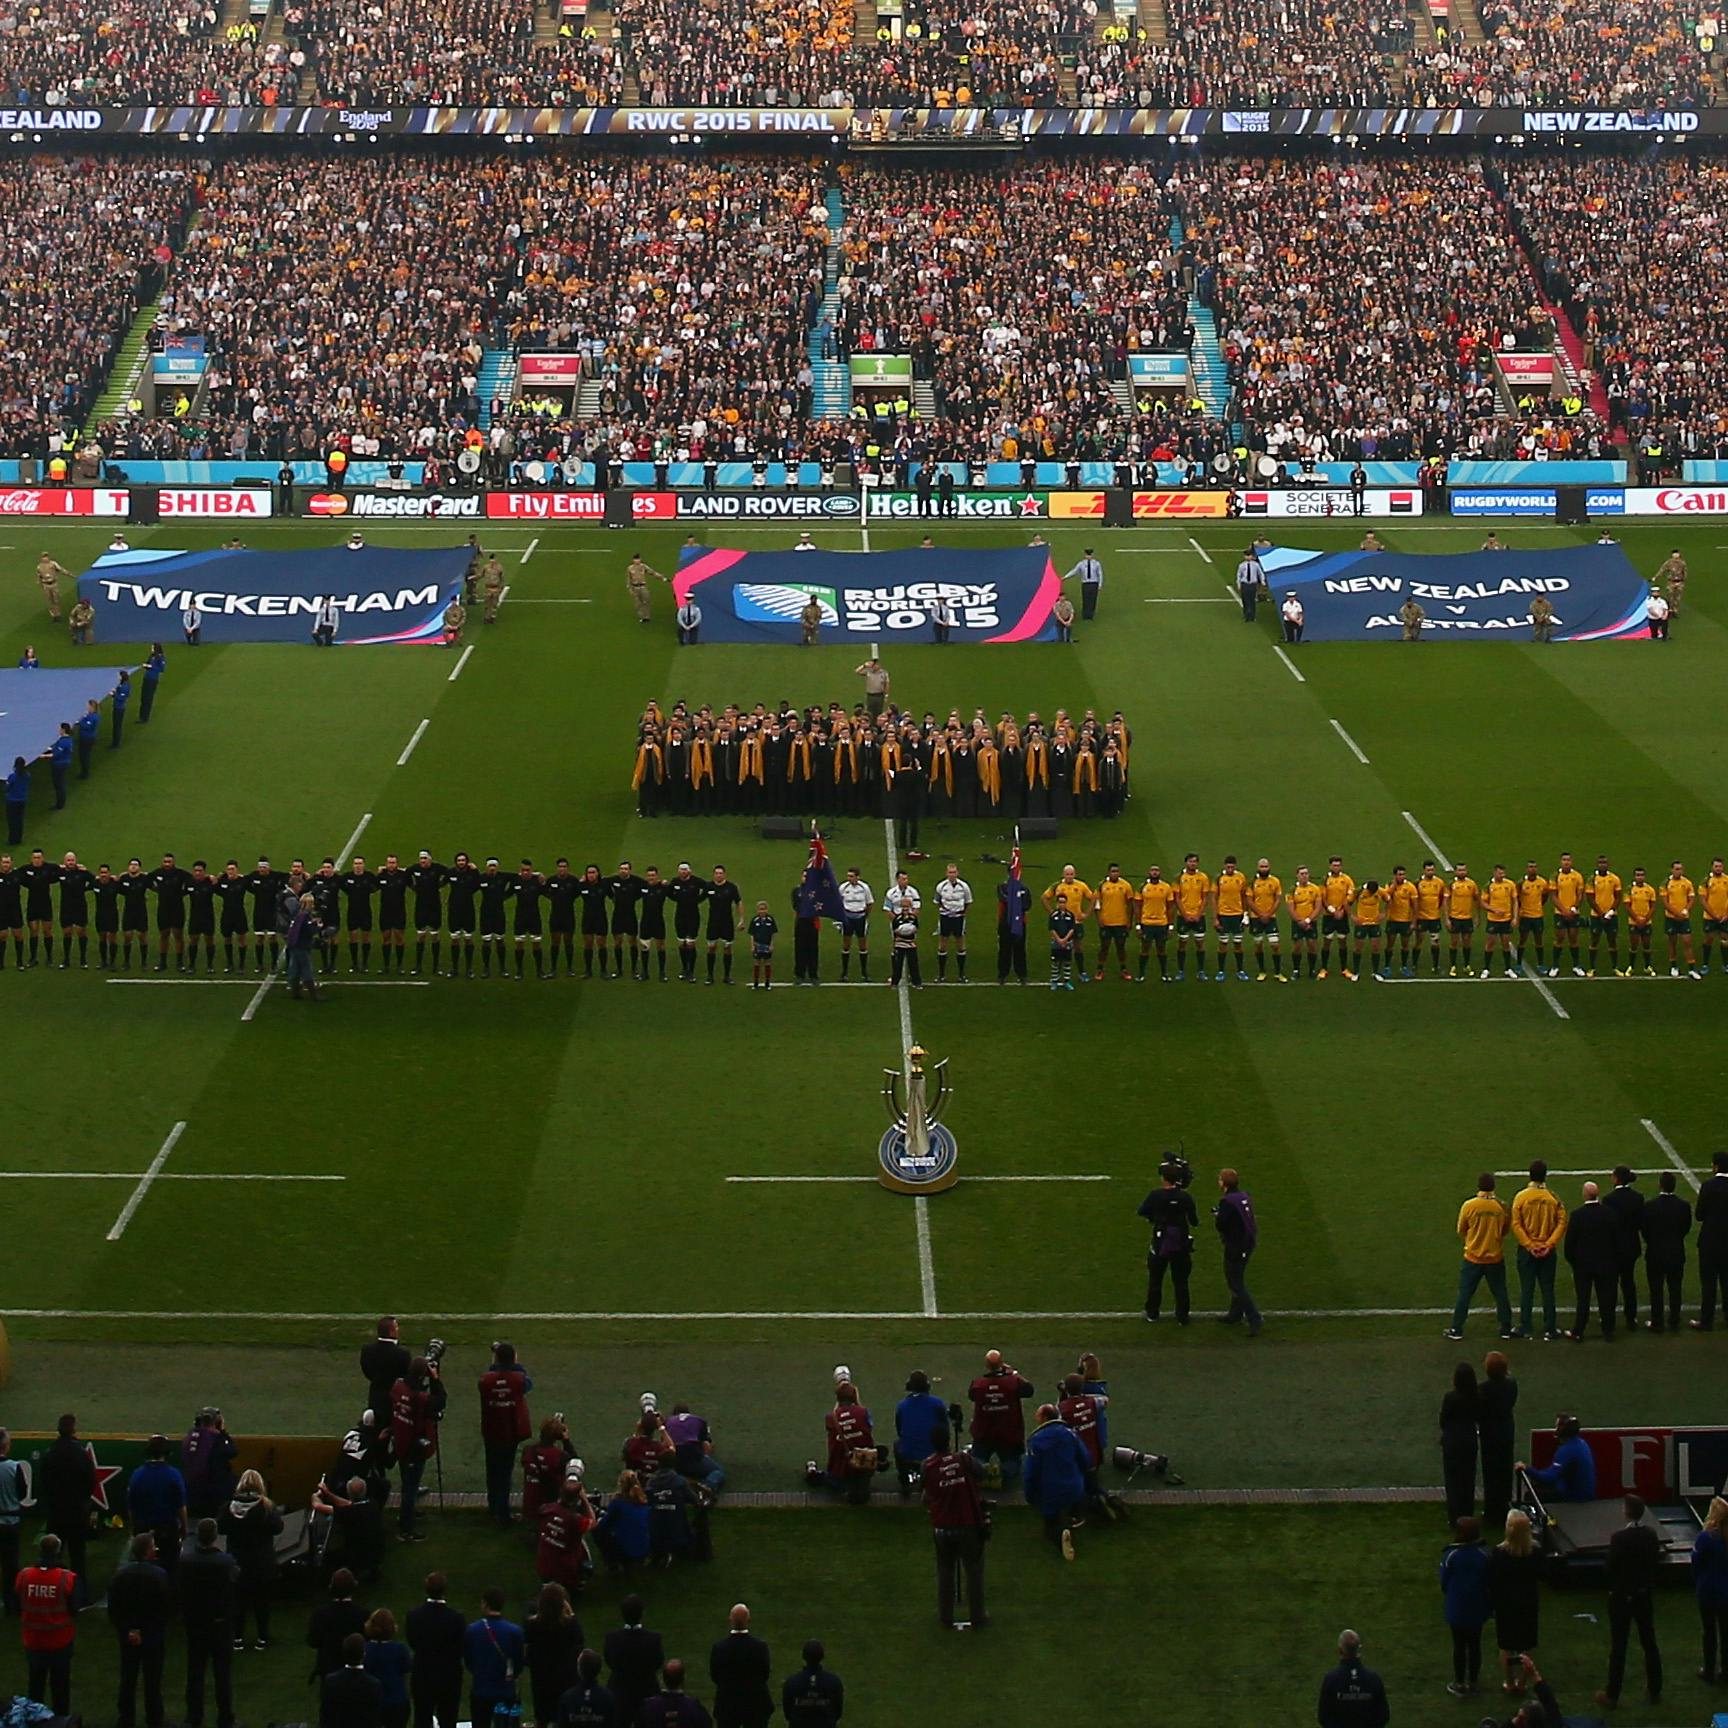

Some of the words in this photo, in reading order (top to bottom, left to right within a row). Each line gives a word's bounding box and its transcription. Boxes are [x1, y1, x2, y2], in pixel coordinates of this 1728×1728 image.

[339, 109, 392, 124] England
[627, 111, 687, 130] RWC
[692, 111, 752, 130] 2015
[759, 111, 835, 130] FINAL
[1523, 112, 1582, 131] NEW
[1241, 123, 1271, 132] 2015
[536, 359, 565, 368] England
[1510, 359, 1537, 367] England
[108, 493, 257, 513] TSHIBA
[508, 494, 549, 516] Fly
[553, 493, 657, 513] Emies
[677, 495, 740, 514] LAND
[743, 495, 822, 514] ROVER
[1454, 495, 1623, 508] RUGBYWORLD.COM
[844, 582, 997, 602] RUGBY
[1324, 575, 1403, 593] NEW
[1409, 576, 1571, 600] ZEALAND
[99, 579, 439, 617] TWICKENHAM
[845, 598, 944, 612] WORLD
[947, 592, 999, 608] CUP
[845, 606, 1000, 632] 2015
[27, 1584, 57, 1598] FIRE
